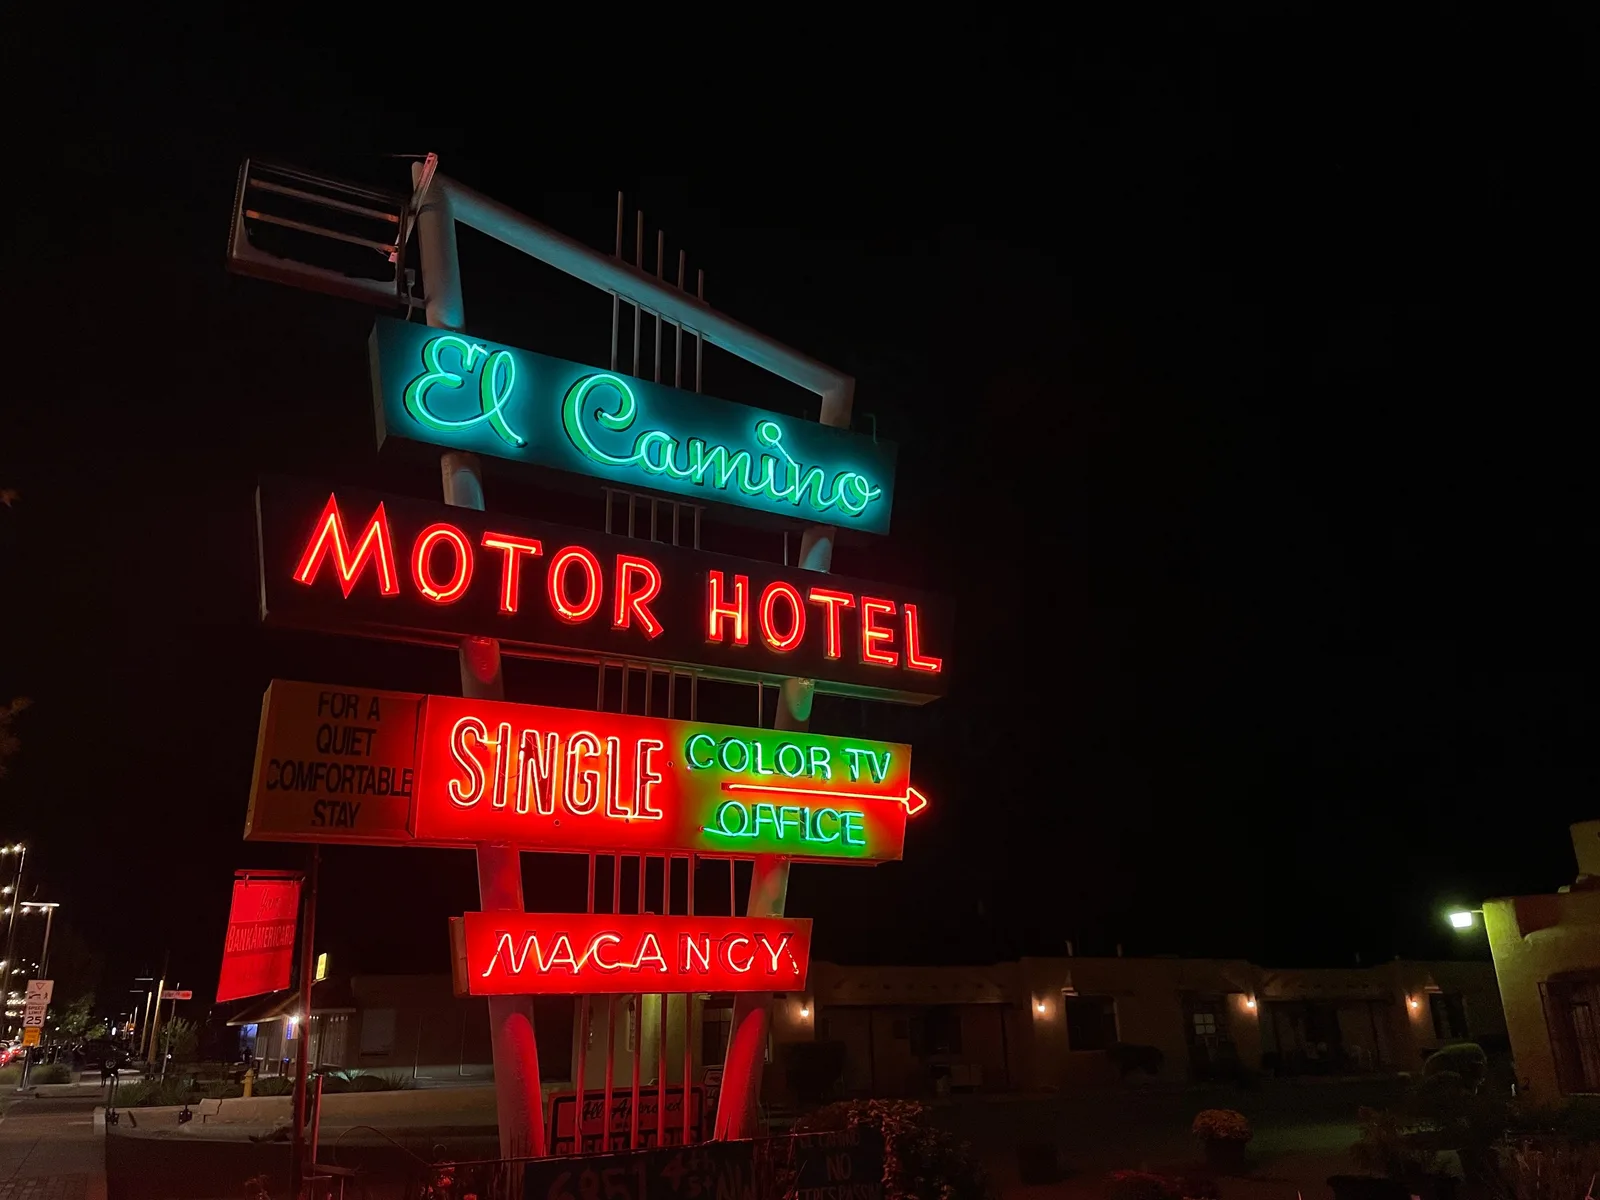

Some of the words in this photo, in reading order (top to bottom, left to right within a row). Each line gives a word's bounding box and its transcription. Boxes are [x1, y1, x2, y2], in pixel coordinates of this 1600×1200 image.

[403, 335, 527, 448] El
[561, 372, 882, 518] Camino
[293, 492, 664, 642] MOTOR
[707, 569, 942, 674] HOTEL
[317, 691, 360, 720] FOR
[367, 696, 381, 722] A
[315, 723, 378, 757] QUIET
[684, 733, 832, 781] COLOR
[841, 747, 892, 784] TV
[266, 758, 414, 797] COMFORTABLE
[447, 715, 664, 820] SINGLE
[311, 799, 362, 829] STAY
[715, 799, 867, 847] OFFICE
[26, 1016, 42, 1025] 25
[826, 1152, 852, 1181] NO
